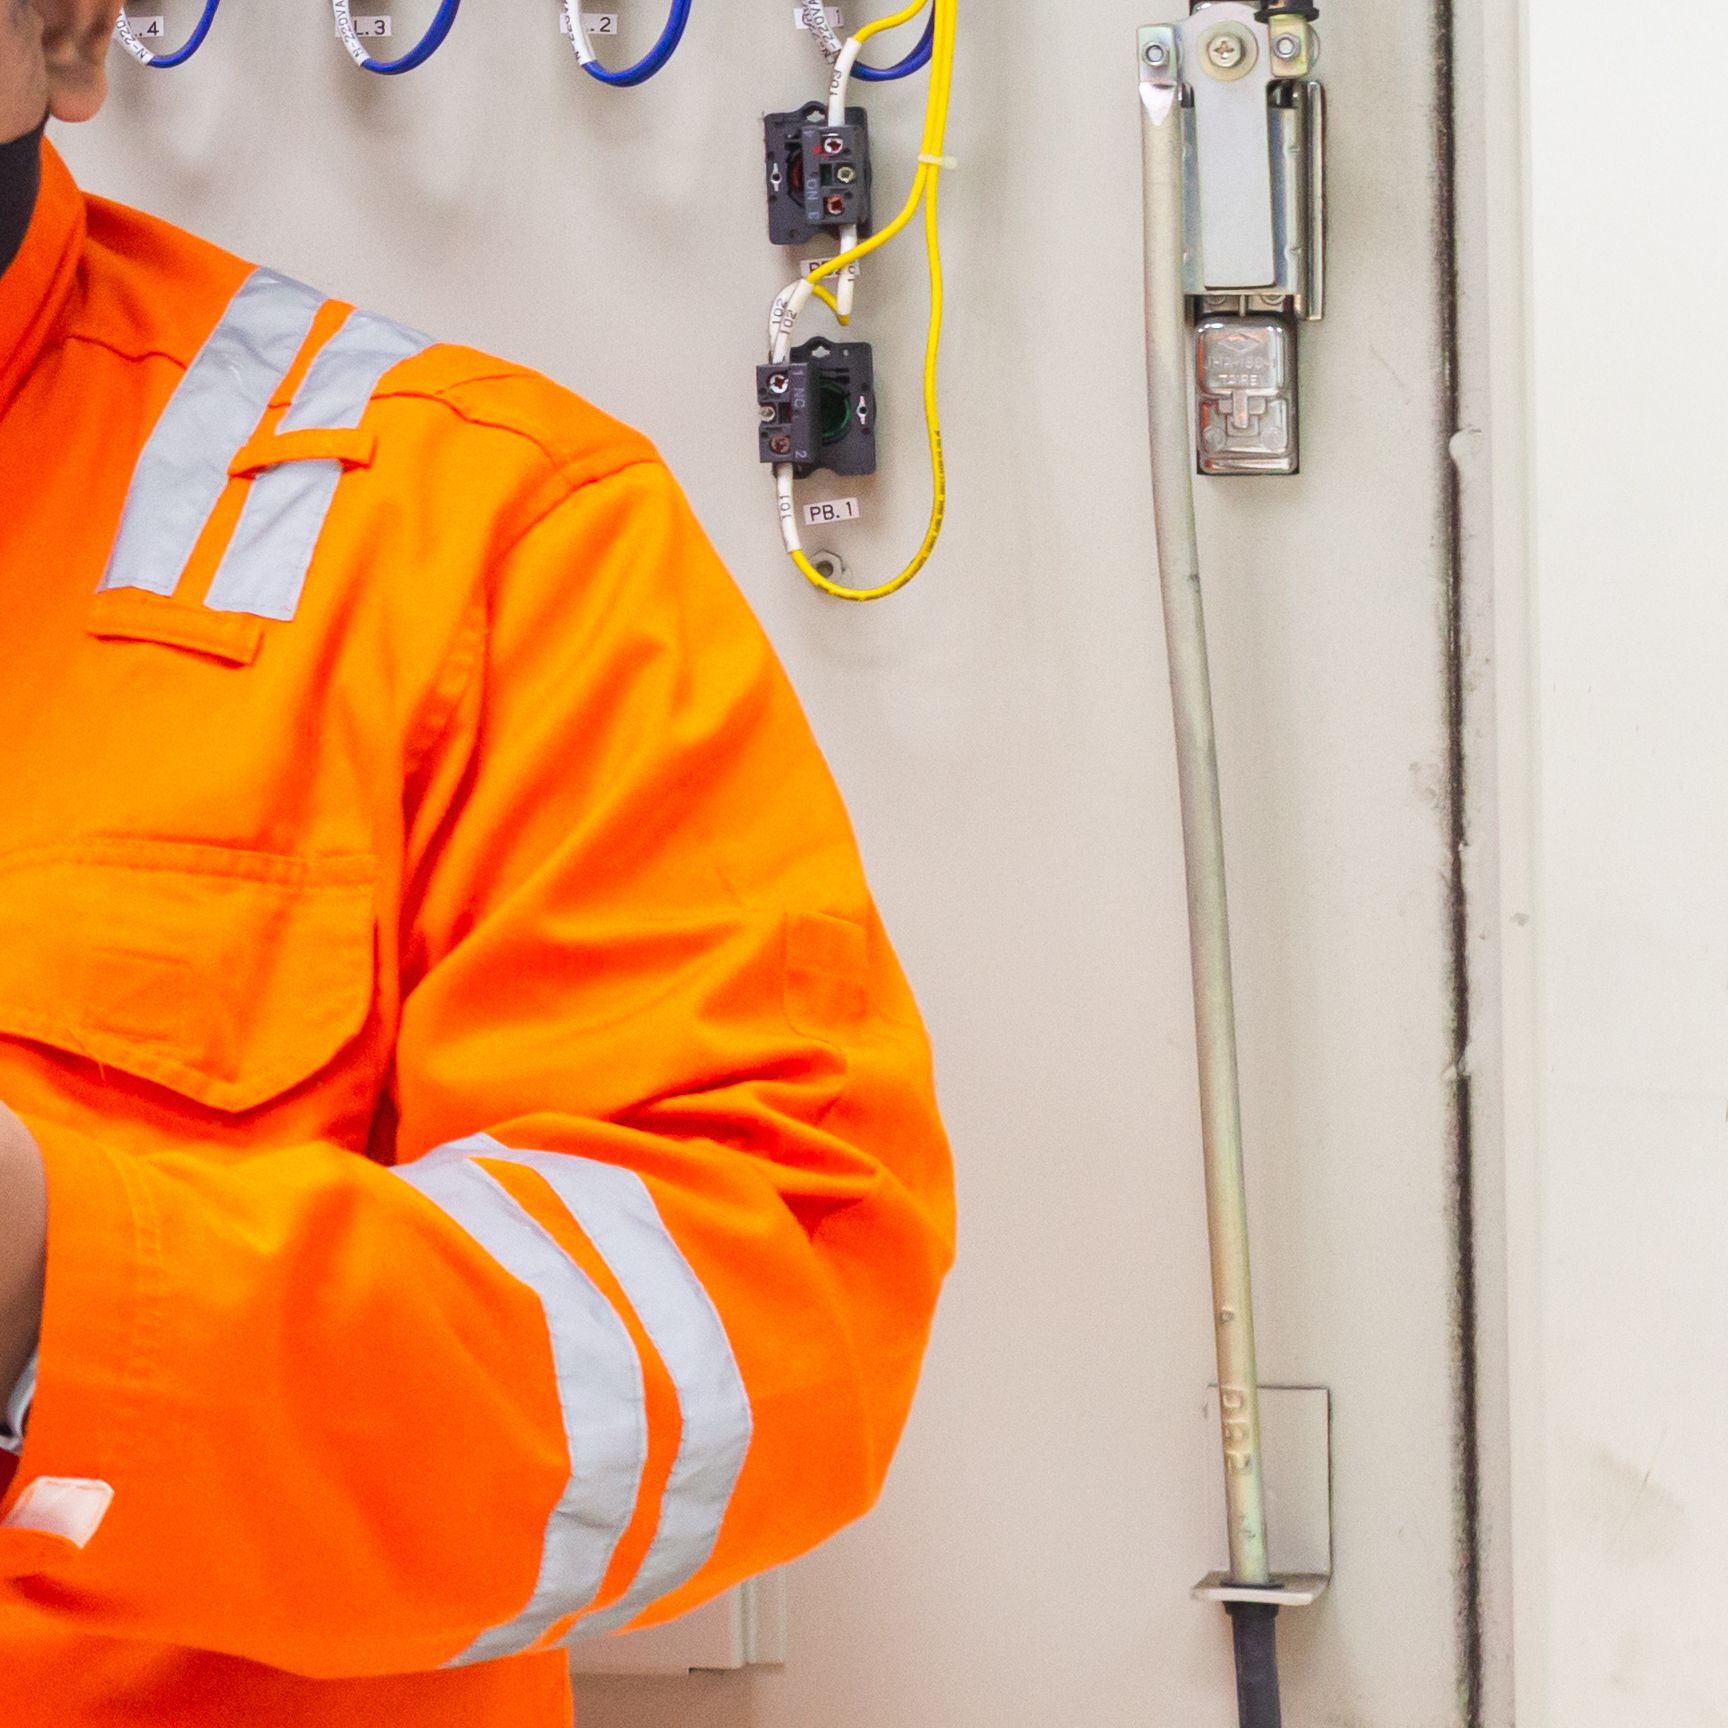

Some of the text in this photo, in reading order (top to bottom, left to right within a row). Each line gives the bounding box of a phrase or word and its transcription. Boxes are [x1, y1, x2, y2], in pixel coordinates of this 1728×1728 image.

[353, 19, 386, 36] L.3
[806, 178, 819, 200] NO
[780, 309, 797, 336] 102
[793, 388, 806, 409] NC
[795, 449, 807, 459] 2
[780, 494, 792, 519] 101
[809, 501, 853, 522] PB.1
